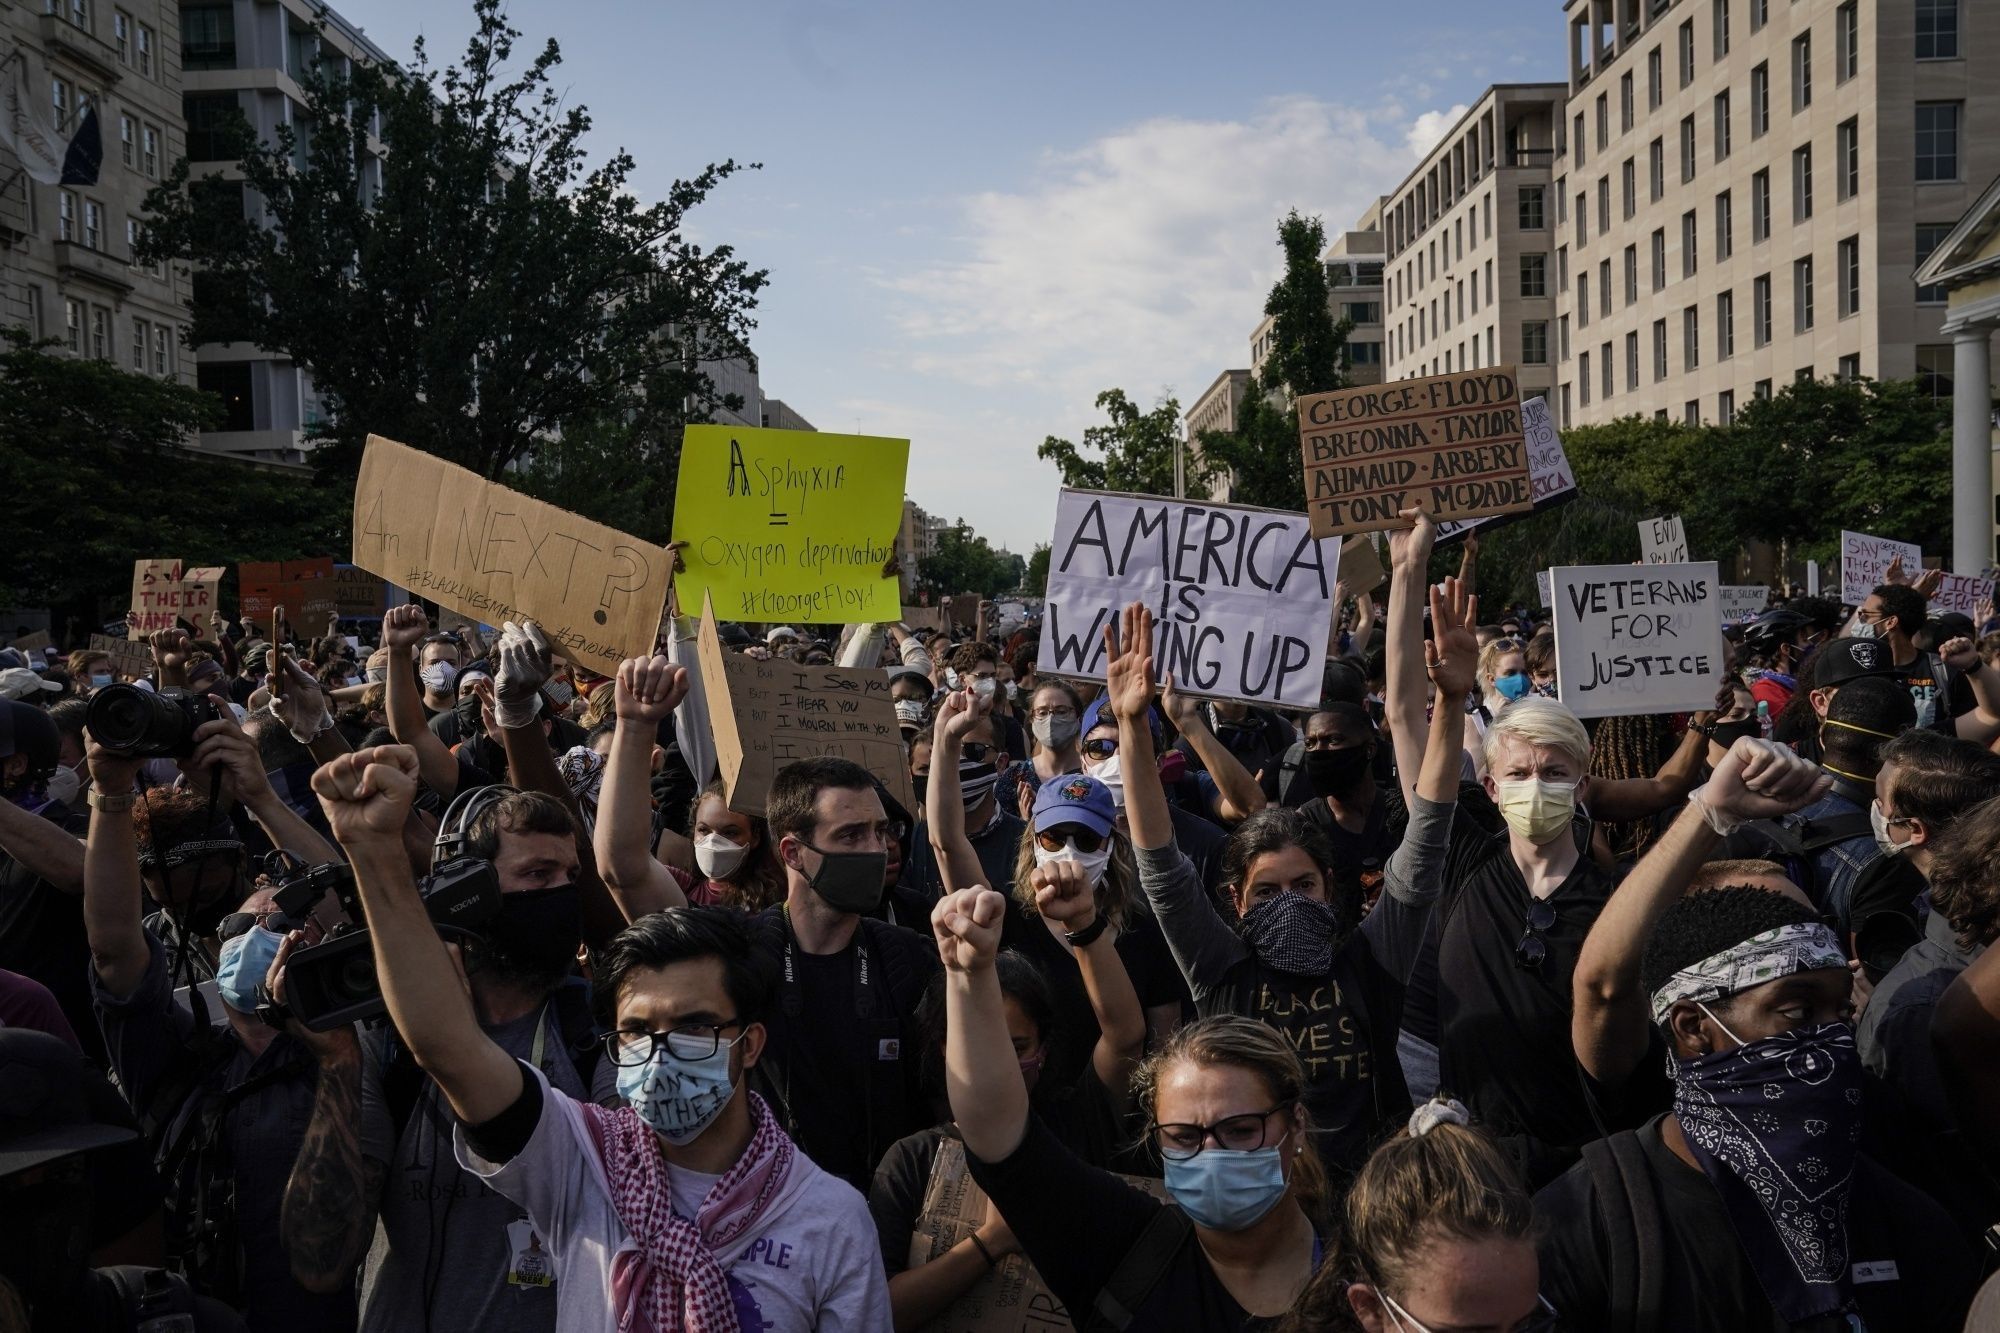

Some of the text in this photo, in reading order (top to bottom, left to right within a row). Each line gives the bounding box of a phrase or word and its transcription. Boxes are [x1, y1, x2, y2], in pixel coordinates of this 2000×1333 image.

[1309, 374, 1514, 425] GEORGE FLOYD
[1311, 408, 1522, 461] BREONNA TAYLOR
[1314, 442, 1521, 499] AHMAUD ARBERY
[1320, 476, 1531, 527] TONY MCDADE
[1652, 520, 1677, 546] END
[359, 488, 400, 557] Am
[453, 504, 650, 626] NEXT?
[700, 536, 894, 578] Oxygen deprivation
[1058, 499, 1329, 600] AMERICA
[1848, 537, 1879, 560] SAY
[142, 562, 209, 586] SAY
[1844, 556, 1882, 574] THEIR
[140, 591, 209, 608] THEIR
[1160, 583, 1205, 623] IS
[1567, 579, 1708, 623] VETERANS
[1737, 589, 1764, 599] SILENCE
[130, 611, 204, 639] NAMES
[406, 566, 627, 662] #BLACKLIVESMATTER #ENOUGH
[1611, 614, 1678, 640] FOR
[1050, 602, 1310, 700] WAING UP
[1579, 651, 1710, 692] JUSTICE
[797, 696, 828, 713] HEAR
[836, 699, 860, 714] YOU
[798, 717, 836, 733] MOURN
[785, 956, 794, 983] Nikon
[860, 958, 868, 985] Nikon
[515, 1274, 544, 1286] PRESS
